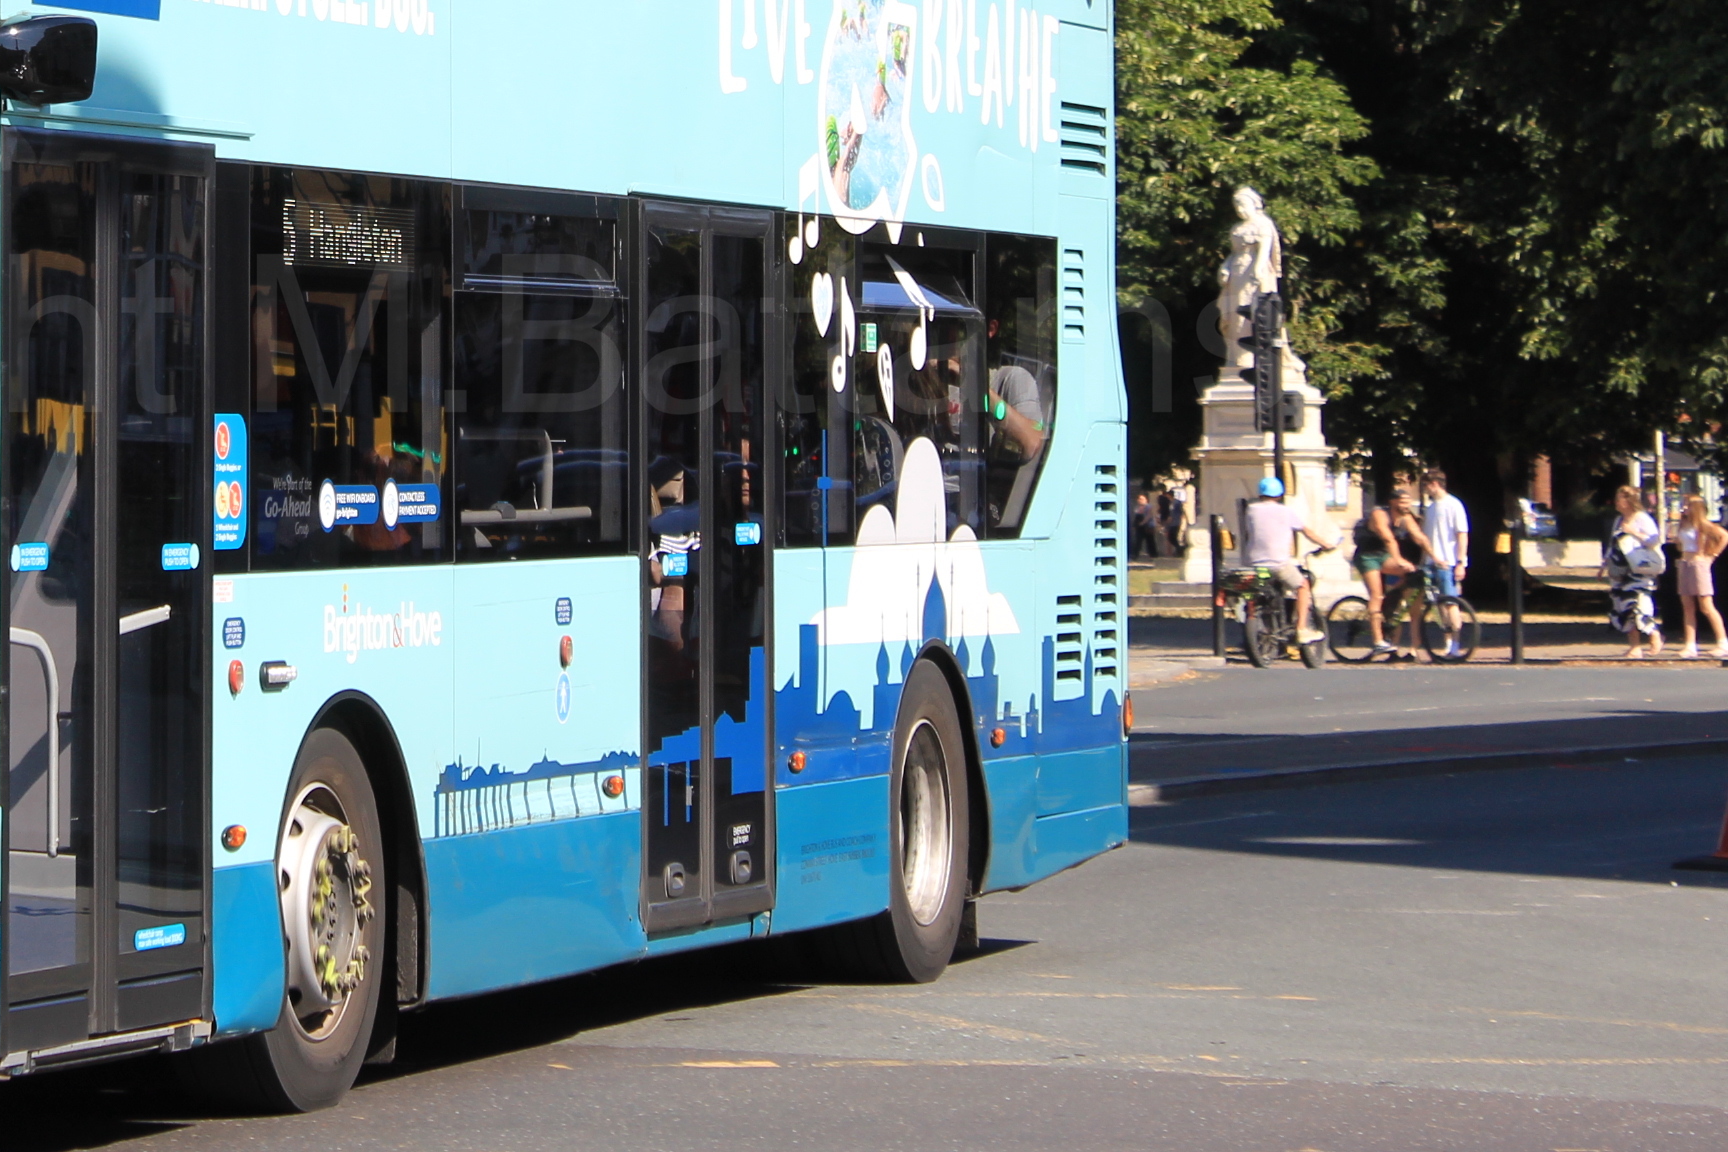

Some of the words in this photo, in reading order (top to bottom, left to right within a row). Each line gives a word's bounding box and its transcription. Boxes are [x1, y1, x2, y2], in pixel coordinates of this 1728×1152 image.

[282, 198, 296, 266] 5
[309, 209, 403, 266] Hangleton
[264, 495, 312, 518] Go-Ahead
